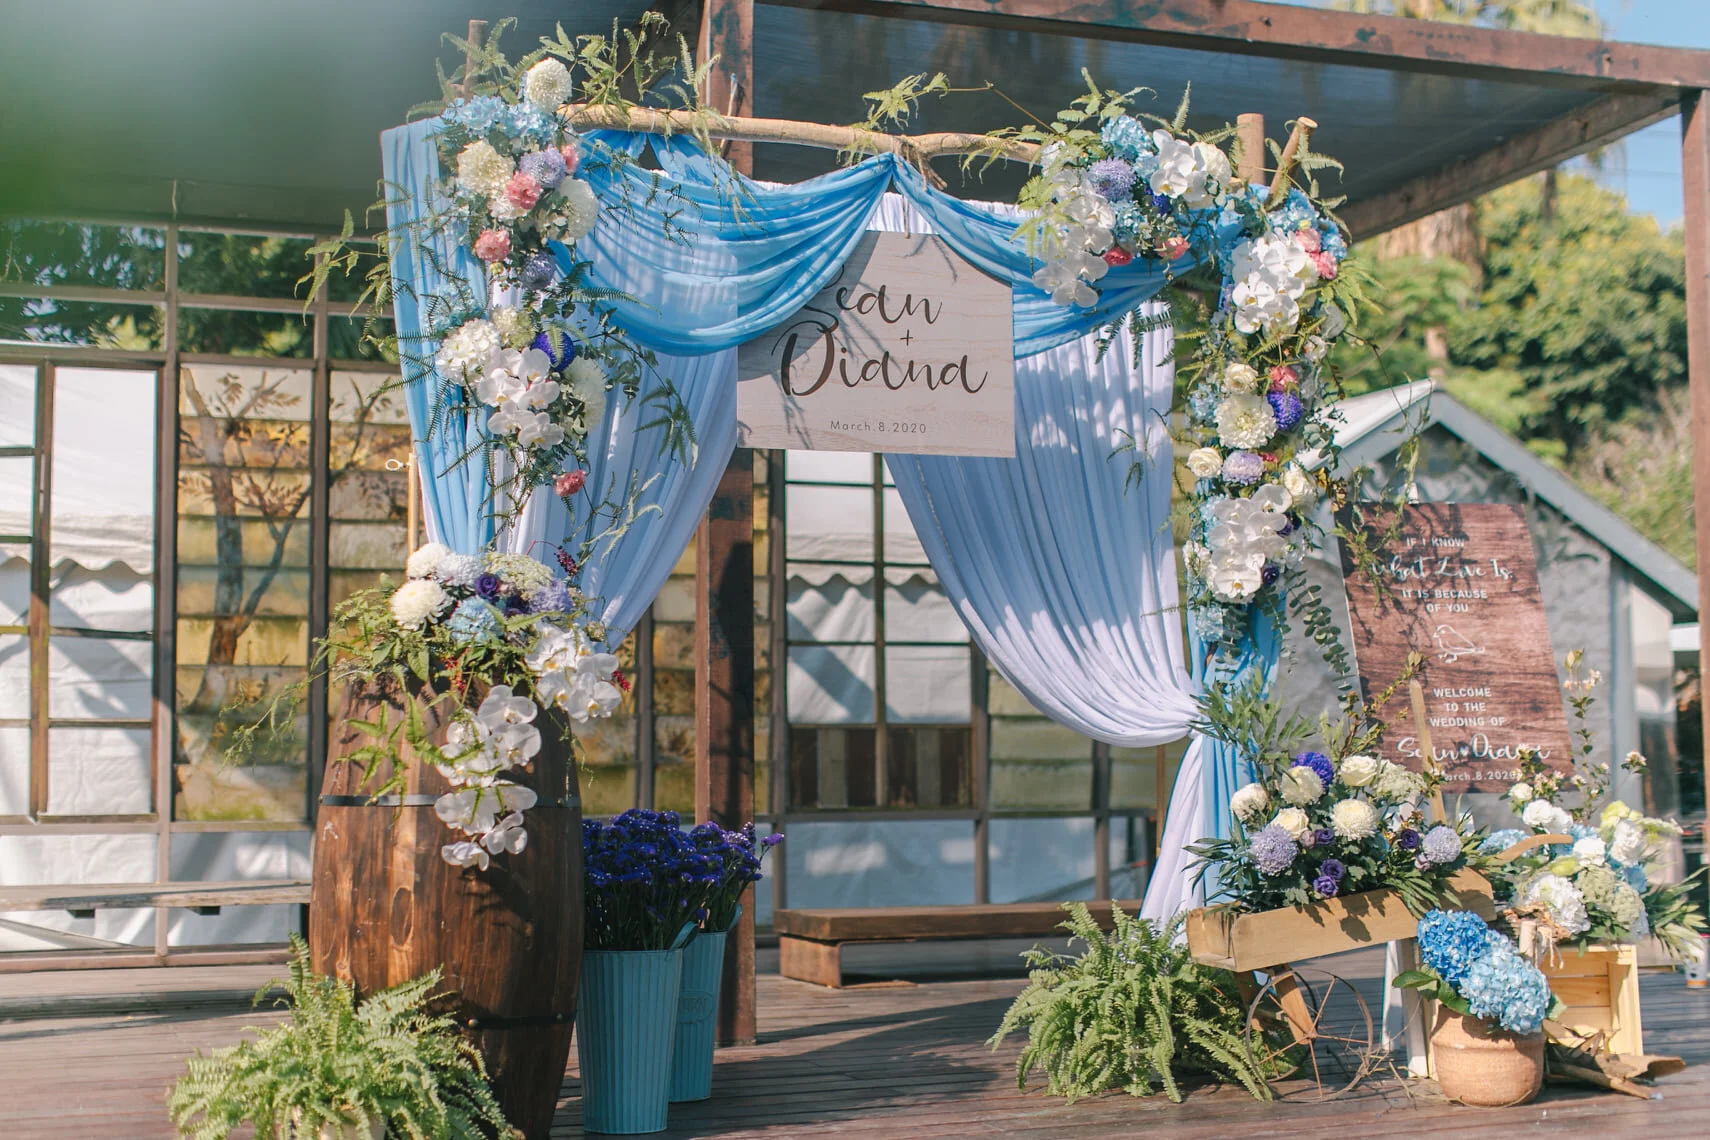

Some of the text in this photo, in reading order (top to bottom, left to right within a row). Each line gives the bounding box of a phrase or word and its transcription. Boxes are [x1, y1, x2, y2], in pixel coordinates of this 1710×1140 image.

[771, 320, 988, 396] Diana
[1406, 537, 1418, 547] IF
[1431, 537, 1465, 548] KNOW
[1402, 589, 1488, 599] IT IS BECAUSE
[1426, 603, 1469, 613] OF YOU
[1433, 687, 1492, 698] WELCOME
[1444, 702, 1487, 712] TO THE
[1429, 716, 1506, 727] WEDDING OF
